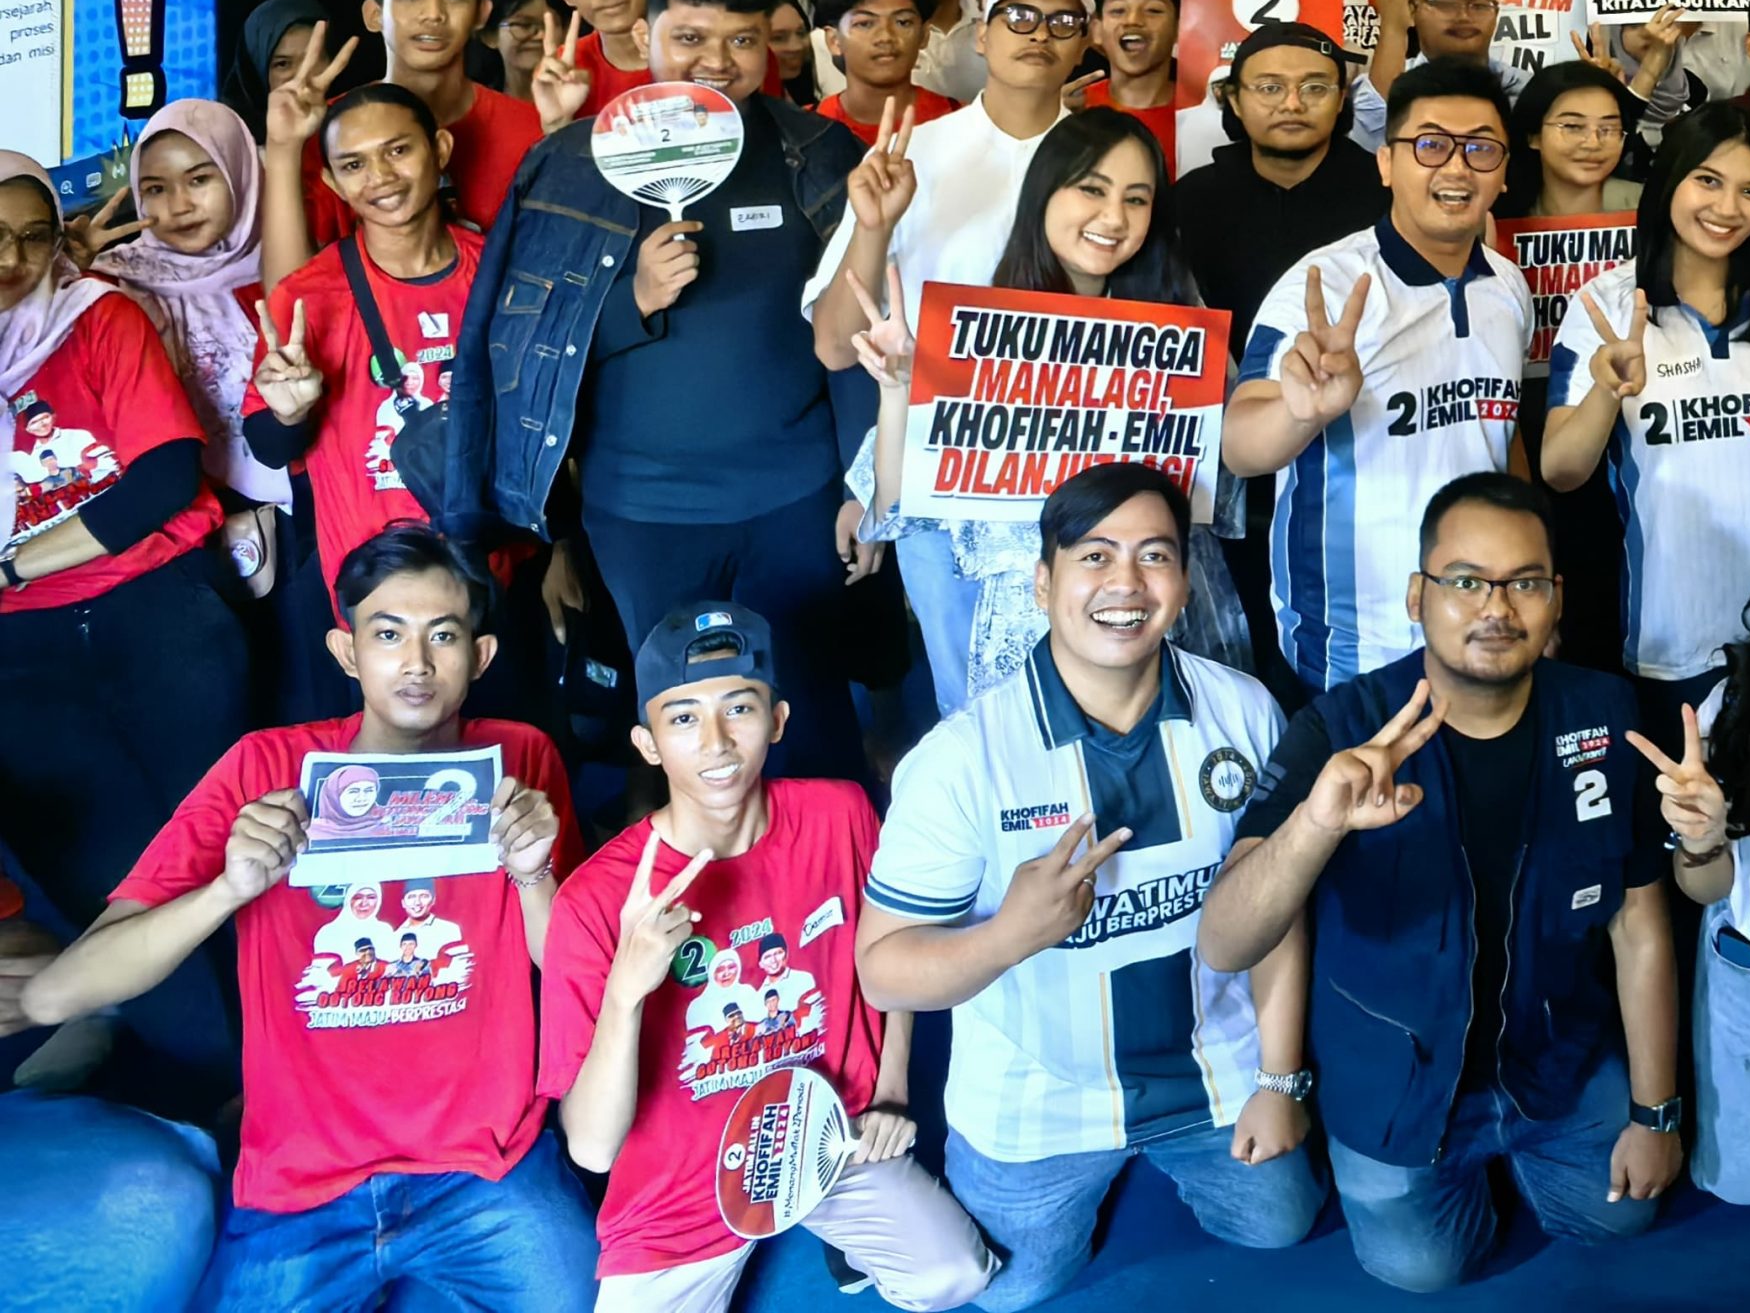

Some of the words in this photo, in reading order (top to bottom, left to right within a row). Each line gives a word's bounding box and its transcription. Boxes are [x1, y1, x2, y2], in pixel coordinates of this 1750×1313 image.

[10, 21, 54, 45] proses
[1494, 14, 1552, 42] ALL
[1511, 46, 1545, 71] IN
[660, 129, 671, 143] 2
[1516, 231, 1584, 265] TUKU
[954, 311, 1049, 362] TUKU
[1050, 318, 1202, 372] MANGGA
[1656, 357, 1702, 378] SHASHA
[974, 359, 1169, 420] MANALAGI,
[1427, 378, 1521, 407] KHOFIFAH
[1387, 391, 1417, 436] 2
[1427, 400, 1477, 430] EMIL
[1640, 402, 1672, 445] 2
[928, 401, 1106, 452] KHOFIFAH
[1121, 412, 1202, 456] EMIL
[1683, 417, 1744, 442] EMIL
[1555, 726, 1609, 746] KHOFIFAH
[1556, 742, 1581, 757] EMIL
[418, 768, 478, 838] 2
[1574, 769, 1613, 822] 2
[1000, 802, 1069, 822] KHOFIFAH
[1001, 818, 1033, 832] EMIL
[729, 917, 774, 948] 2024
[681, 940, 707, 982] 2
[347, 973, 431, 993] RELAWAN
[391, 997, 468, 1024] BERPRESTASI
[728, 1150, 742, 1161] 2
[752, 1105, 778, 1202] KHOFIFAH
[765, 1158, 782, 1200] EMIL
